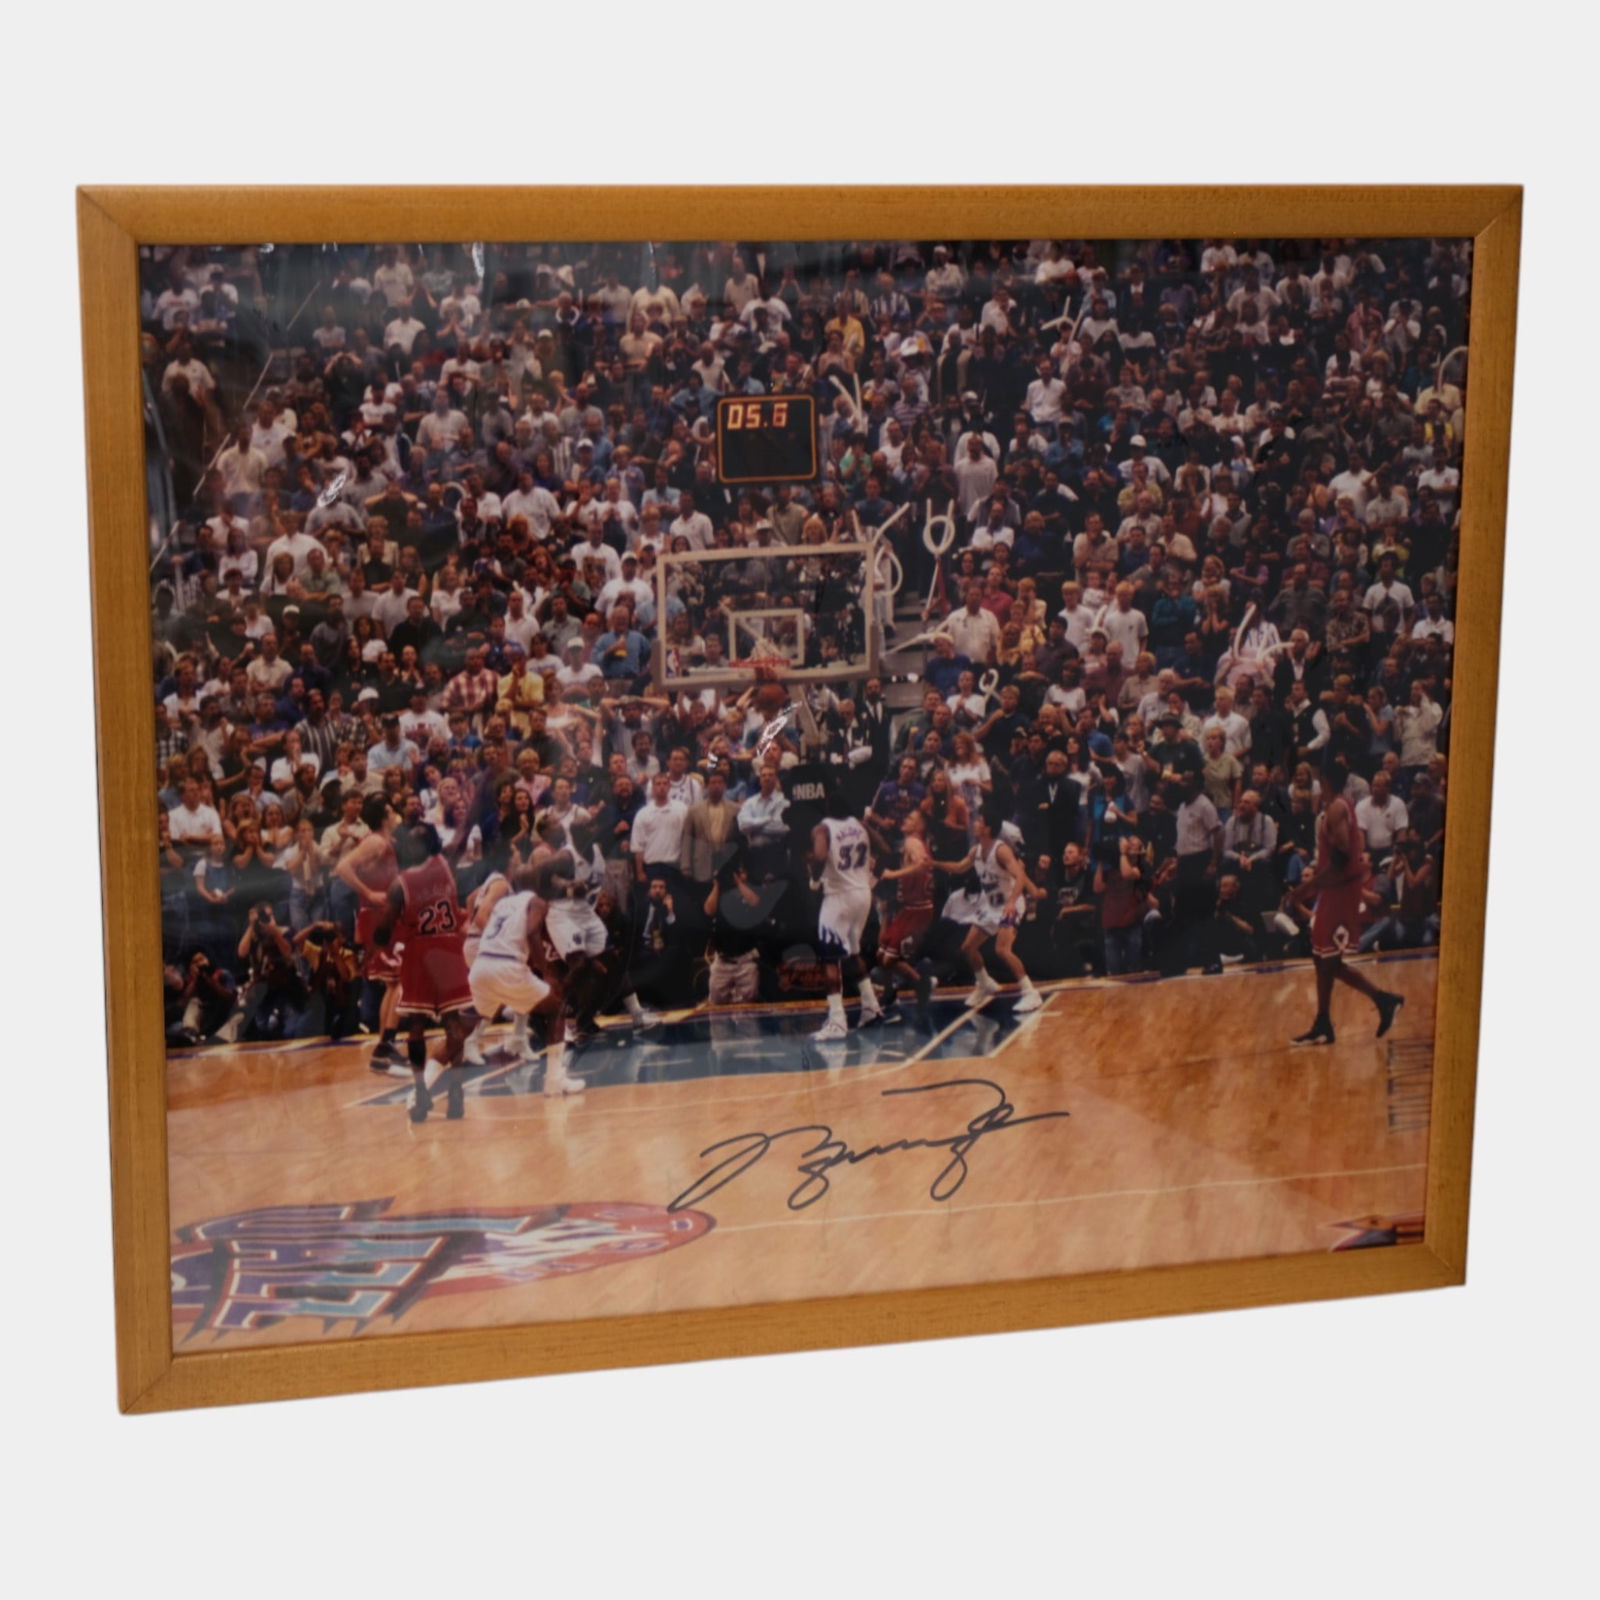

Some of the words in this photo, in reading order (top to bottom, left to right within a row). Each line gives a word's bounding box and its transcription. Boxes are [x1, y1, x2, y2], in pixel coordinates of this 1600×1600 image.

[727, 402, 788, 430] 05.6
[796, 782, 826, 800] NBA
[418, 899, 456, 935] 23
